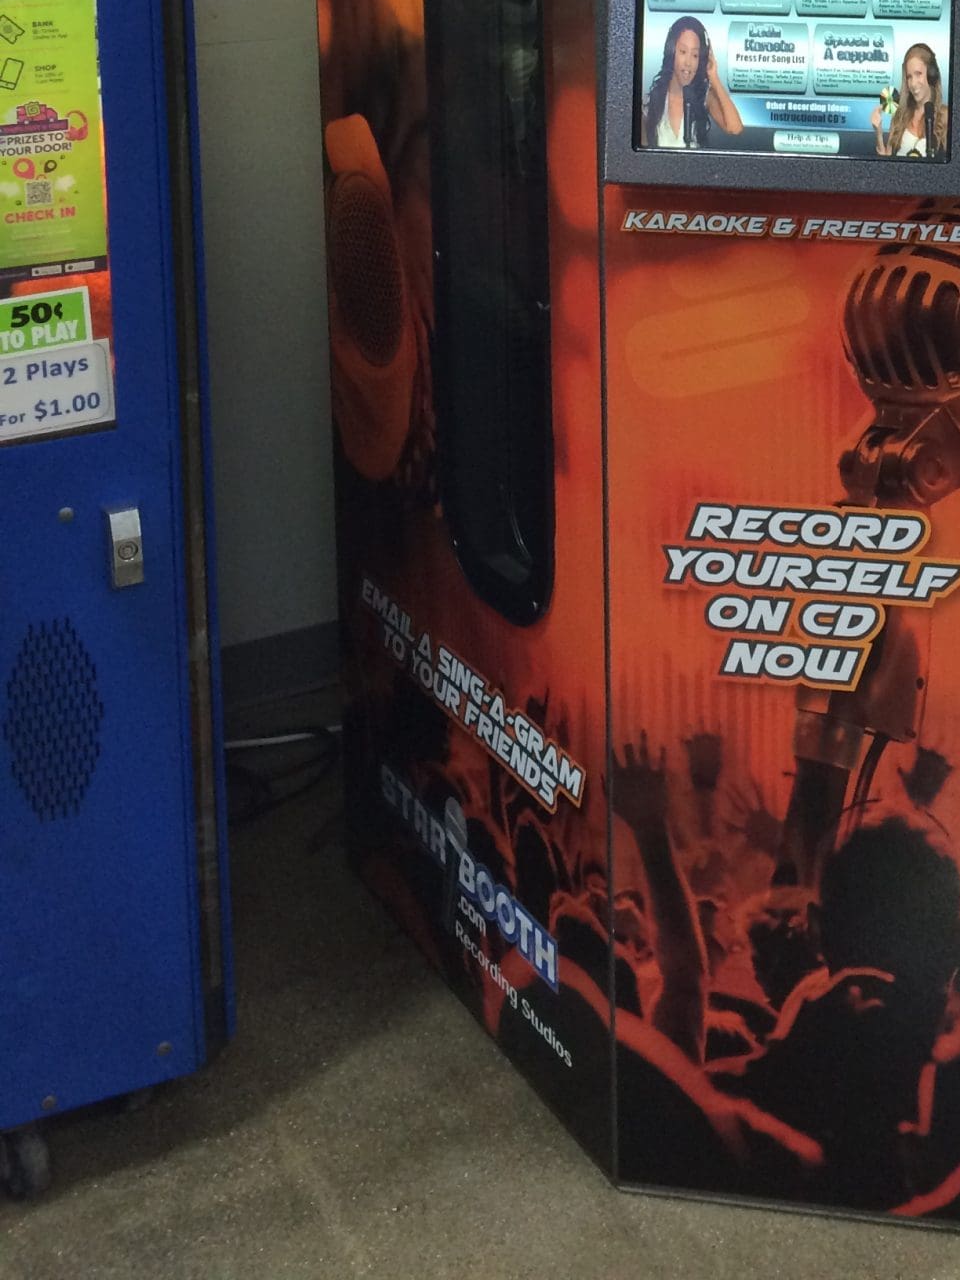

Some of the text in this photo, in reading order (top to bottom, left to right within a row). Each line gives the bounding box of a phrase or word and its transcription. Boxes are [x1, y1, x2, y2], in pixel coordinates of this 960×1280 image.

[735, 53, 805, 64] Press For Song List
[823, 47, 834, 60] A
[34, 64, 57, 72] SHOP
[765, 101, 786, 110] Other
[787, 102, 827, 112] Recording
[770, 111, 826, 122] Instructional
[0, 141, 72, 157] YOUR DOOR!
[7, 131, 64, 145] PRIZES TO
[787, 133, 804, 142] Help
[814, 134, 829, 143] Tips
[5, 205, 76, 225] CHECK IN
[624, 211, 767, 234] KARAOKE
[772, 218, 796, 234] &
[11, 302, 63, 329] 50¢
[0, 320, 79, 351] TO PLAY
[4, 357, 89, 385] 2 Plays
[34, 392, 101, 422] $1.00
[689, 506, 922, 551] RECORD
[667, 549, 959, 598] YOURSELF
[708, 597, 877, 637] ON CD
[723, 642, 860, 682] NOW
[361, 578, 583, 798] EMAIL A SING-A-GRAM
[383, 624, 555, 807] TO YOUR FRIENDS
[380, 765, 556, 983] STAR BOOTH
[457, 895, 488, 937] .com
[455, 920, 573, 1068] Recording Studios
